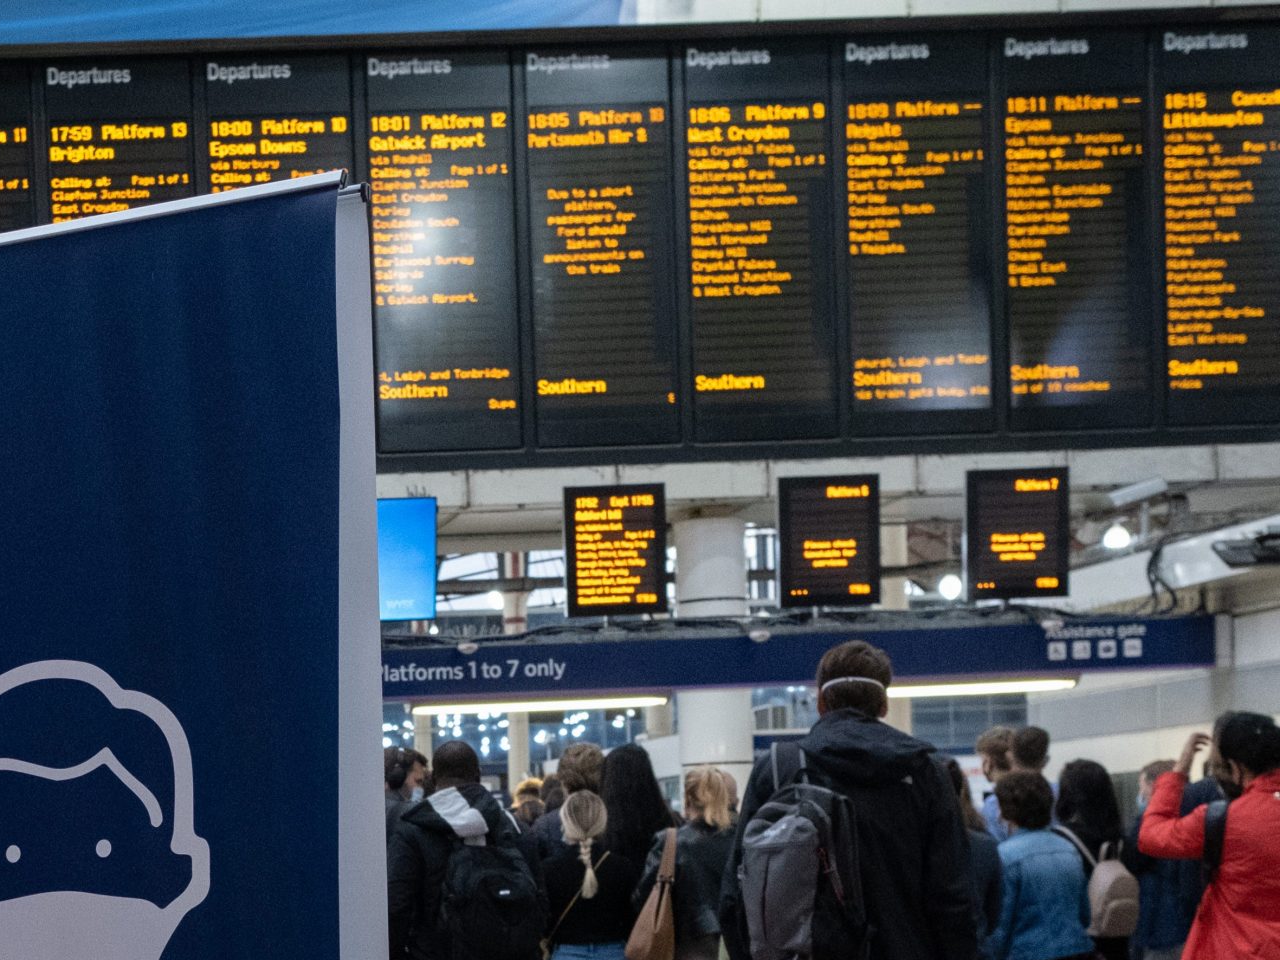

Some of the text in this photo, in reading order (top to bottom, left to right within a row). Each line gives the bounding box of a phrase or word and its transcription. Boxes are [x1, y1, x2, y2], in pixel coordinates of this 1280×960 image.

[845, 43, 930, 64] Departures
[1005, 38, 1089, 59] Departures
[1164, 32, 1248, 54] Departures
[368, 58, 452, 80] Departures
[526, 54, 610, 75] Departures
[686, 49, 771, 70] Departures
[47, 67, 131, 88] Departures
[207, 63, 291, 84] Departures
[101, 125, 166, 140] Platform
[261, 120, 325, 135] Platform
[331, 117, 347, 133] 10
[421, 114, 485, 130] Platform
[13, 128, 27, 143] 11
[369, 133, 485, 152] Gatwick Airport
[49, 146, 115, 163] Brighton
[209, 139, 307, 158] Epsom Downs
[380, 384, 448, 399] Southern
[381, 658, 566, 682] latforms 1 to 7 only
